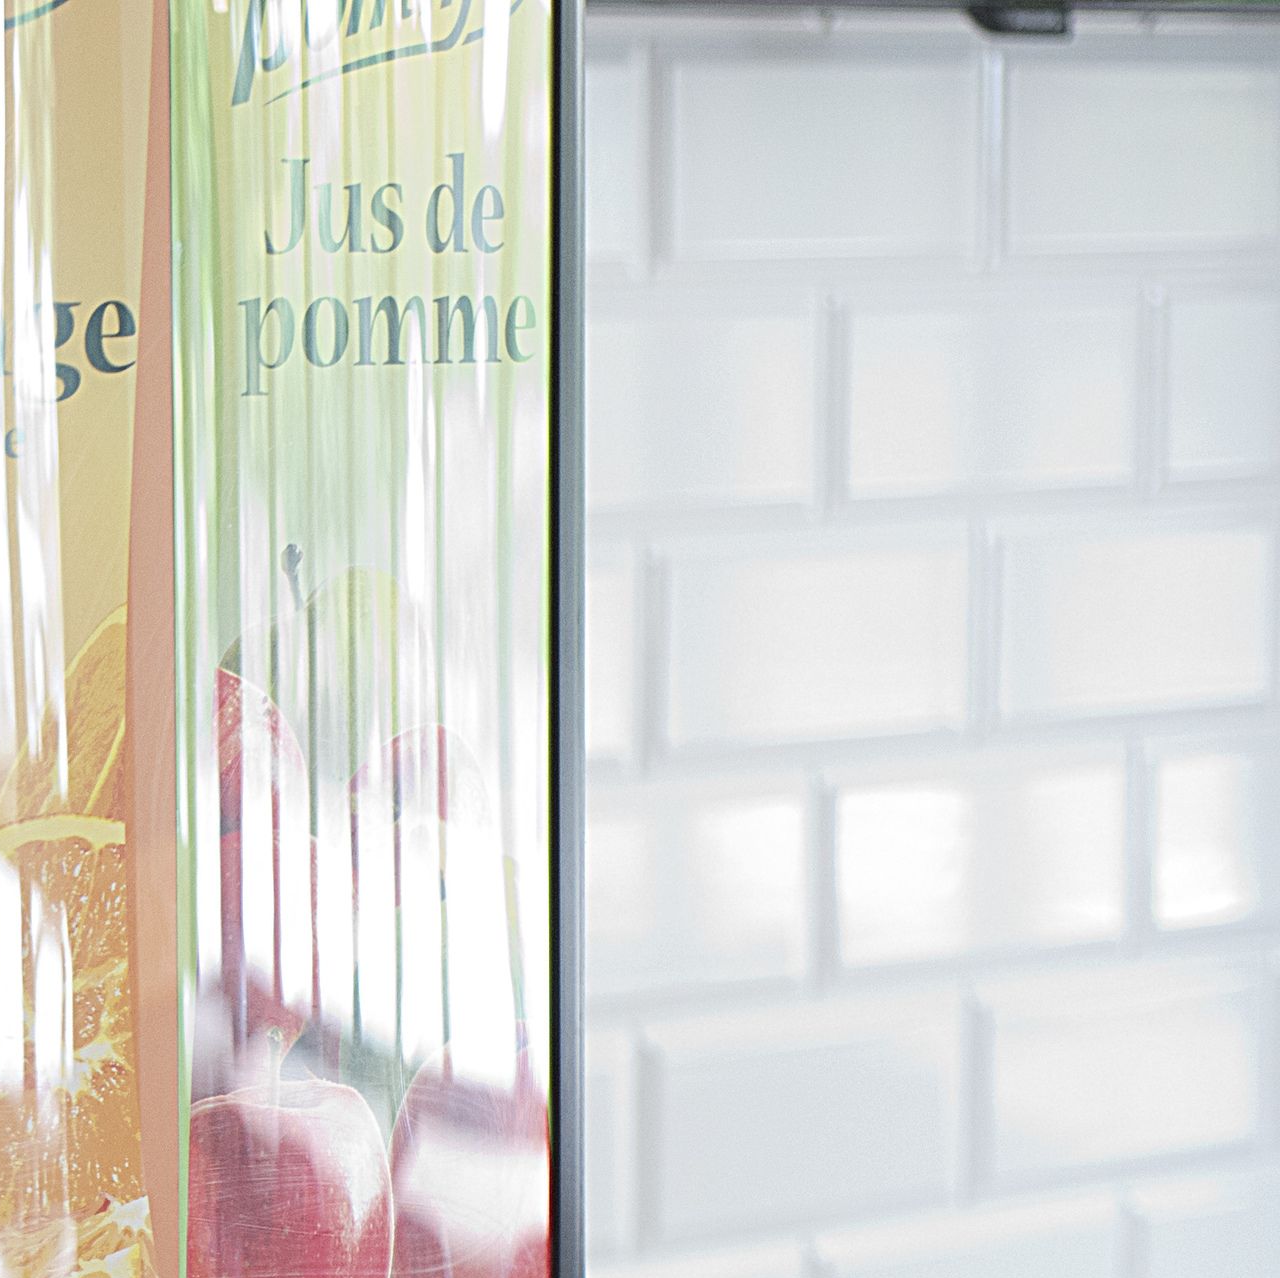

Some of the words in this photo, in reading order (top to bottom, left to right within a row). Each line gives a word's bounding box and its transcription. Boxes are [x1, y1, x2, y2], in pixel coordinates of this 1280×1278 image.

[264, 157, 404, 255] Jus
[426, 152, 505, 253] de
[238, 294, 537, 397] pomme
